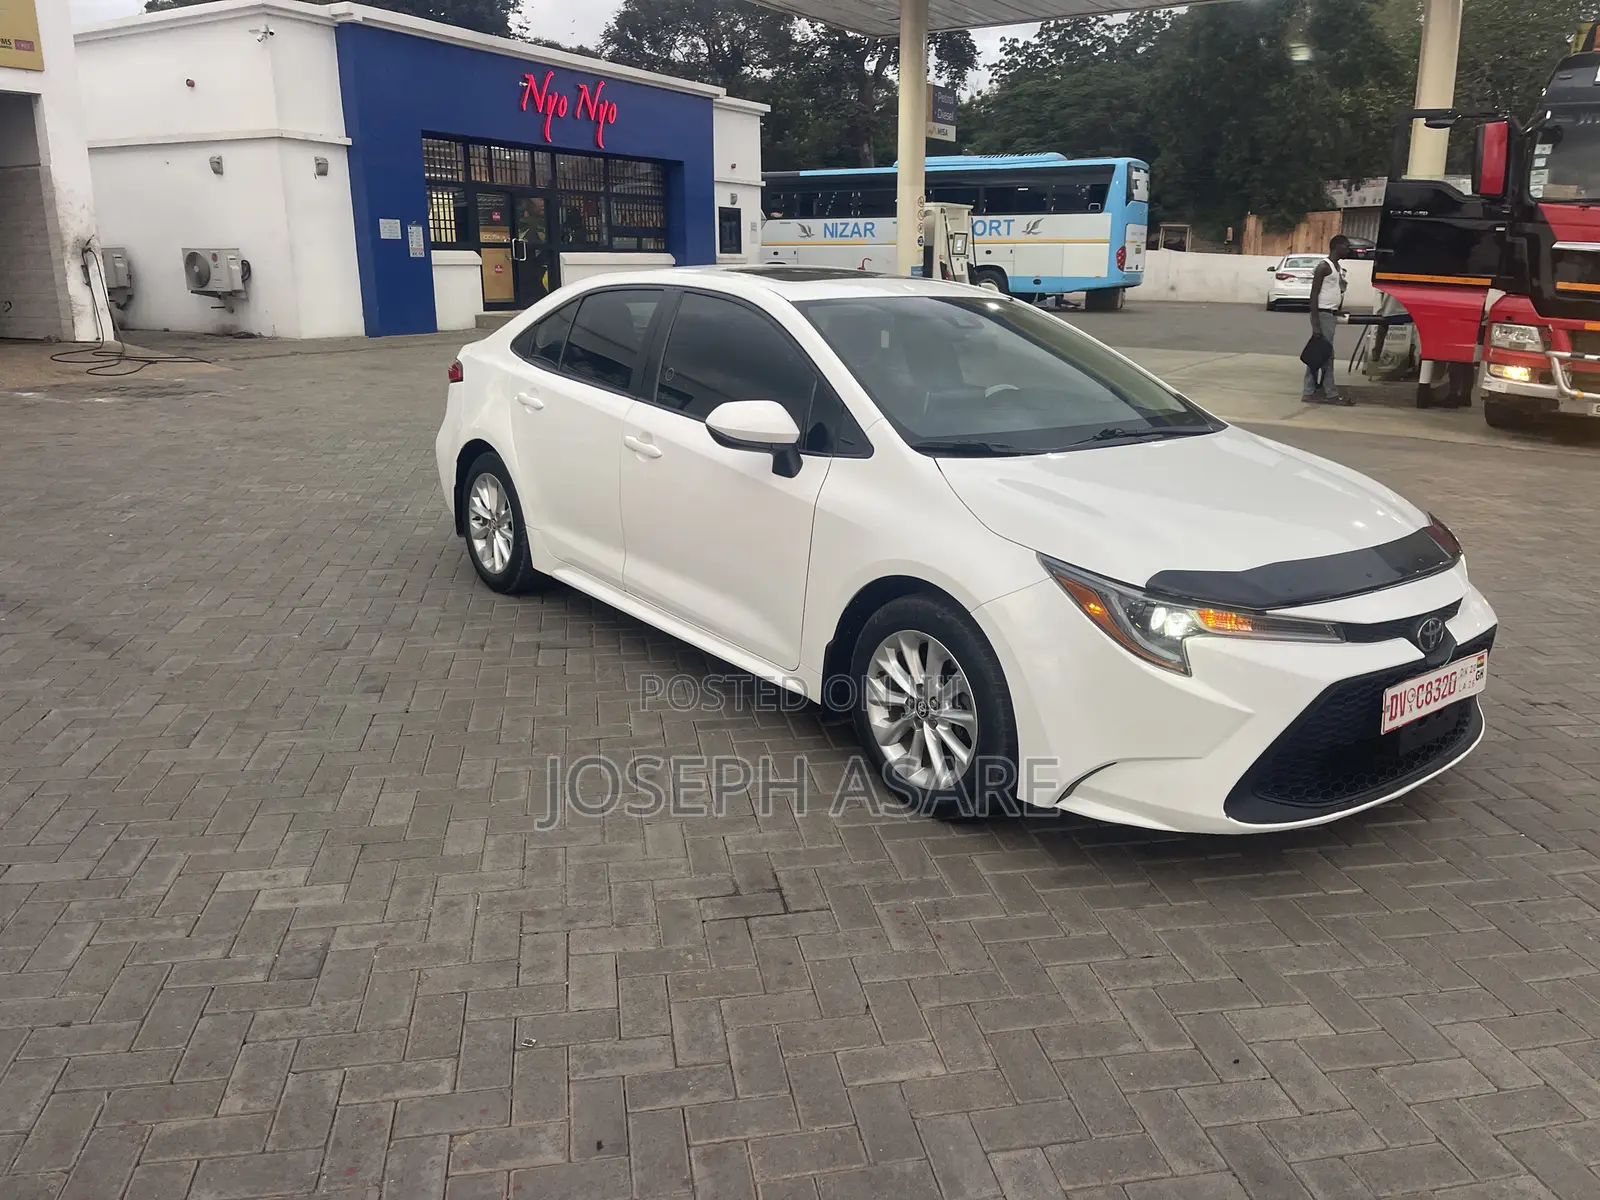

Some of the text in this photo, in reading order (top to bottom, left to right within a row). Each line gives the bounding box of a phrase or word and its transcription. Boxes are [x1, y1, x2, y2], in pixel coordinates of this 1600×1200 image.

[937, 91, 954, 105] Petrol
[521, 70, 617, 149] Nyo Nyo
[937, 108, 954, 121] Diesel
[823, 221, 876, 238] NIZAR
[1388, 689, 1407, 722] DV
